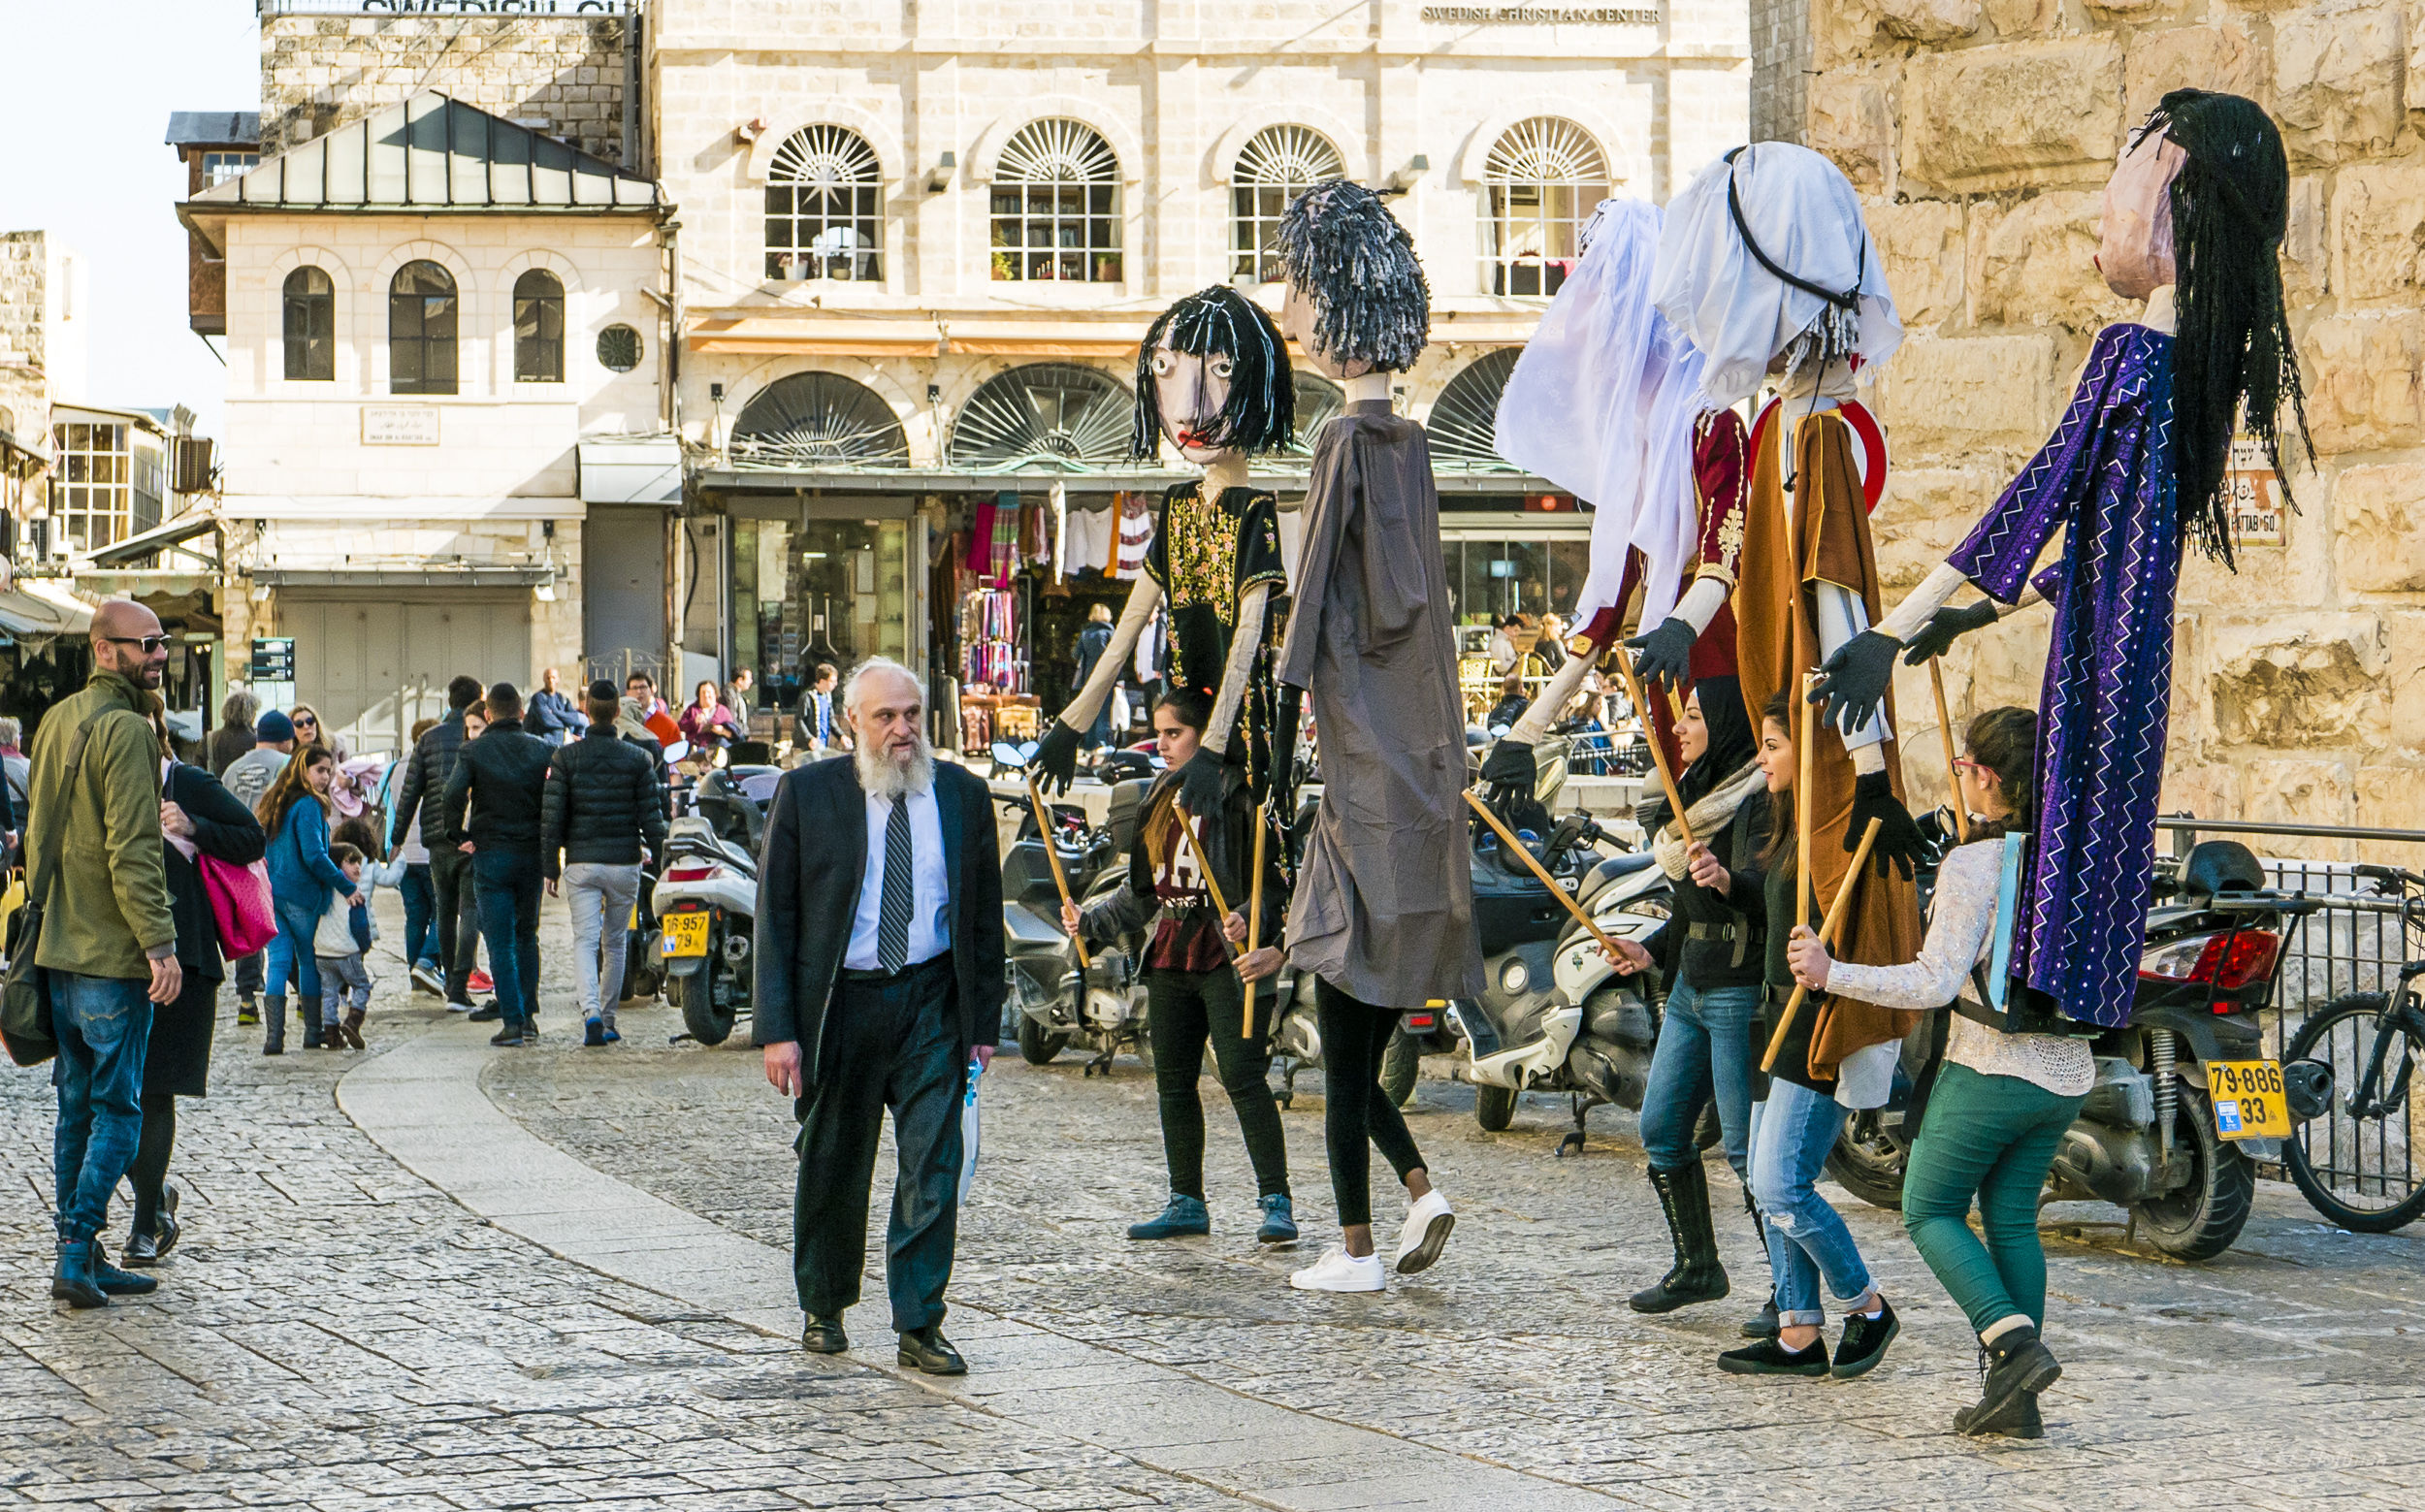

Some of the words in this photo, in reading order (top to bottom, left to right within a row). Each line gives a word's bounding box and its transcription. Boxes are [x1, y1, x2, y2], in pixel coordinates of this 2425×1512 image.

[1422, 6, 1493, 21] SWEDISH
[1498, 7, 1588, 22] CHRISTIAN
[1594, 8, 1662, 22] CENTER
[676, 933, 692, 949] 79
[2212, 1067, 2281, 1094] 79-886
[2241, 1097, 2267, 1124] 33
